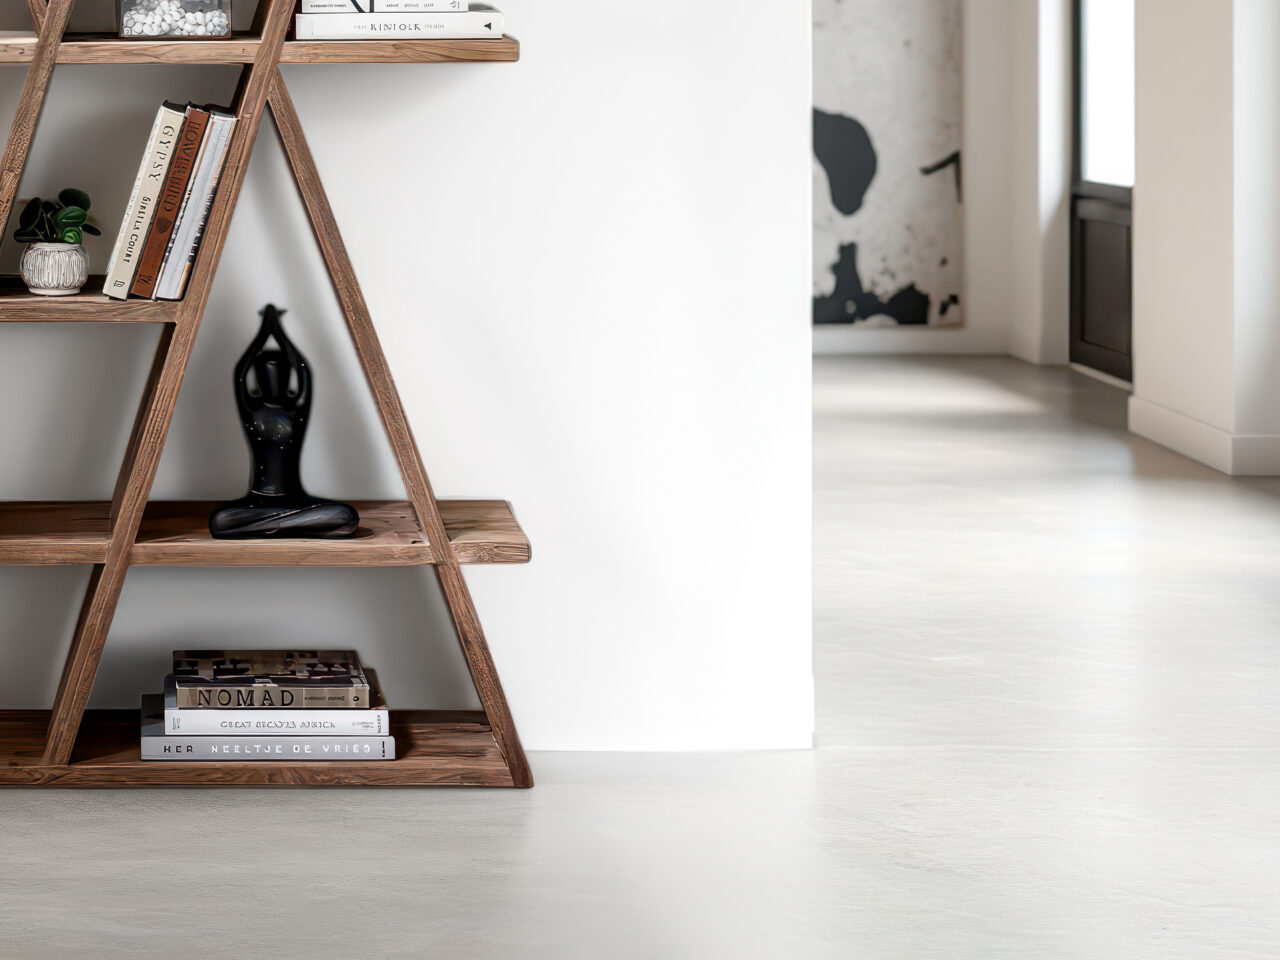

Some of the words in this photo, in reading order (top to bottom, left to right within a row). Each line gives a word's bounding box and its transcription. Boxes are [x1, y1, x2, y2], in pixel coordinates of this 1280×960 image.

[148, 124, 175, 181] GYPSY
[197, 689, 295, 707] NOMAD
[163, 745, 194, 754] HER
[210, 744, 283, 754] NEELTJE
[292, 744, 312, 754] DE
